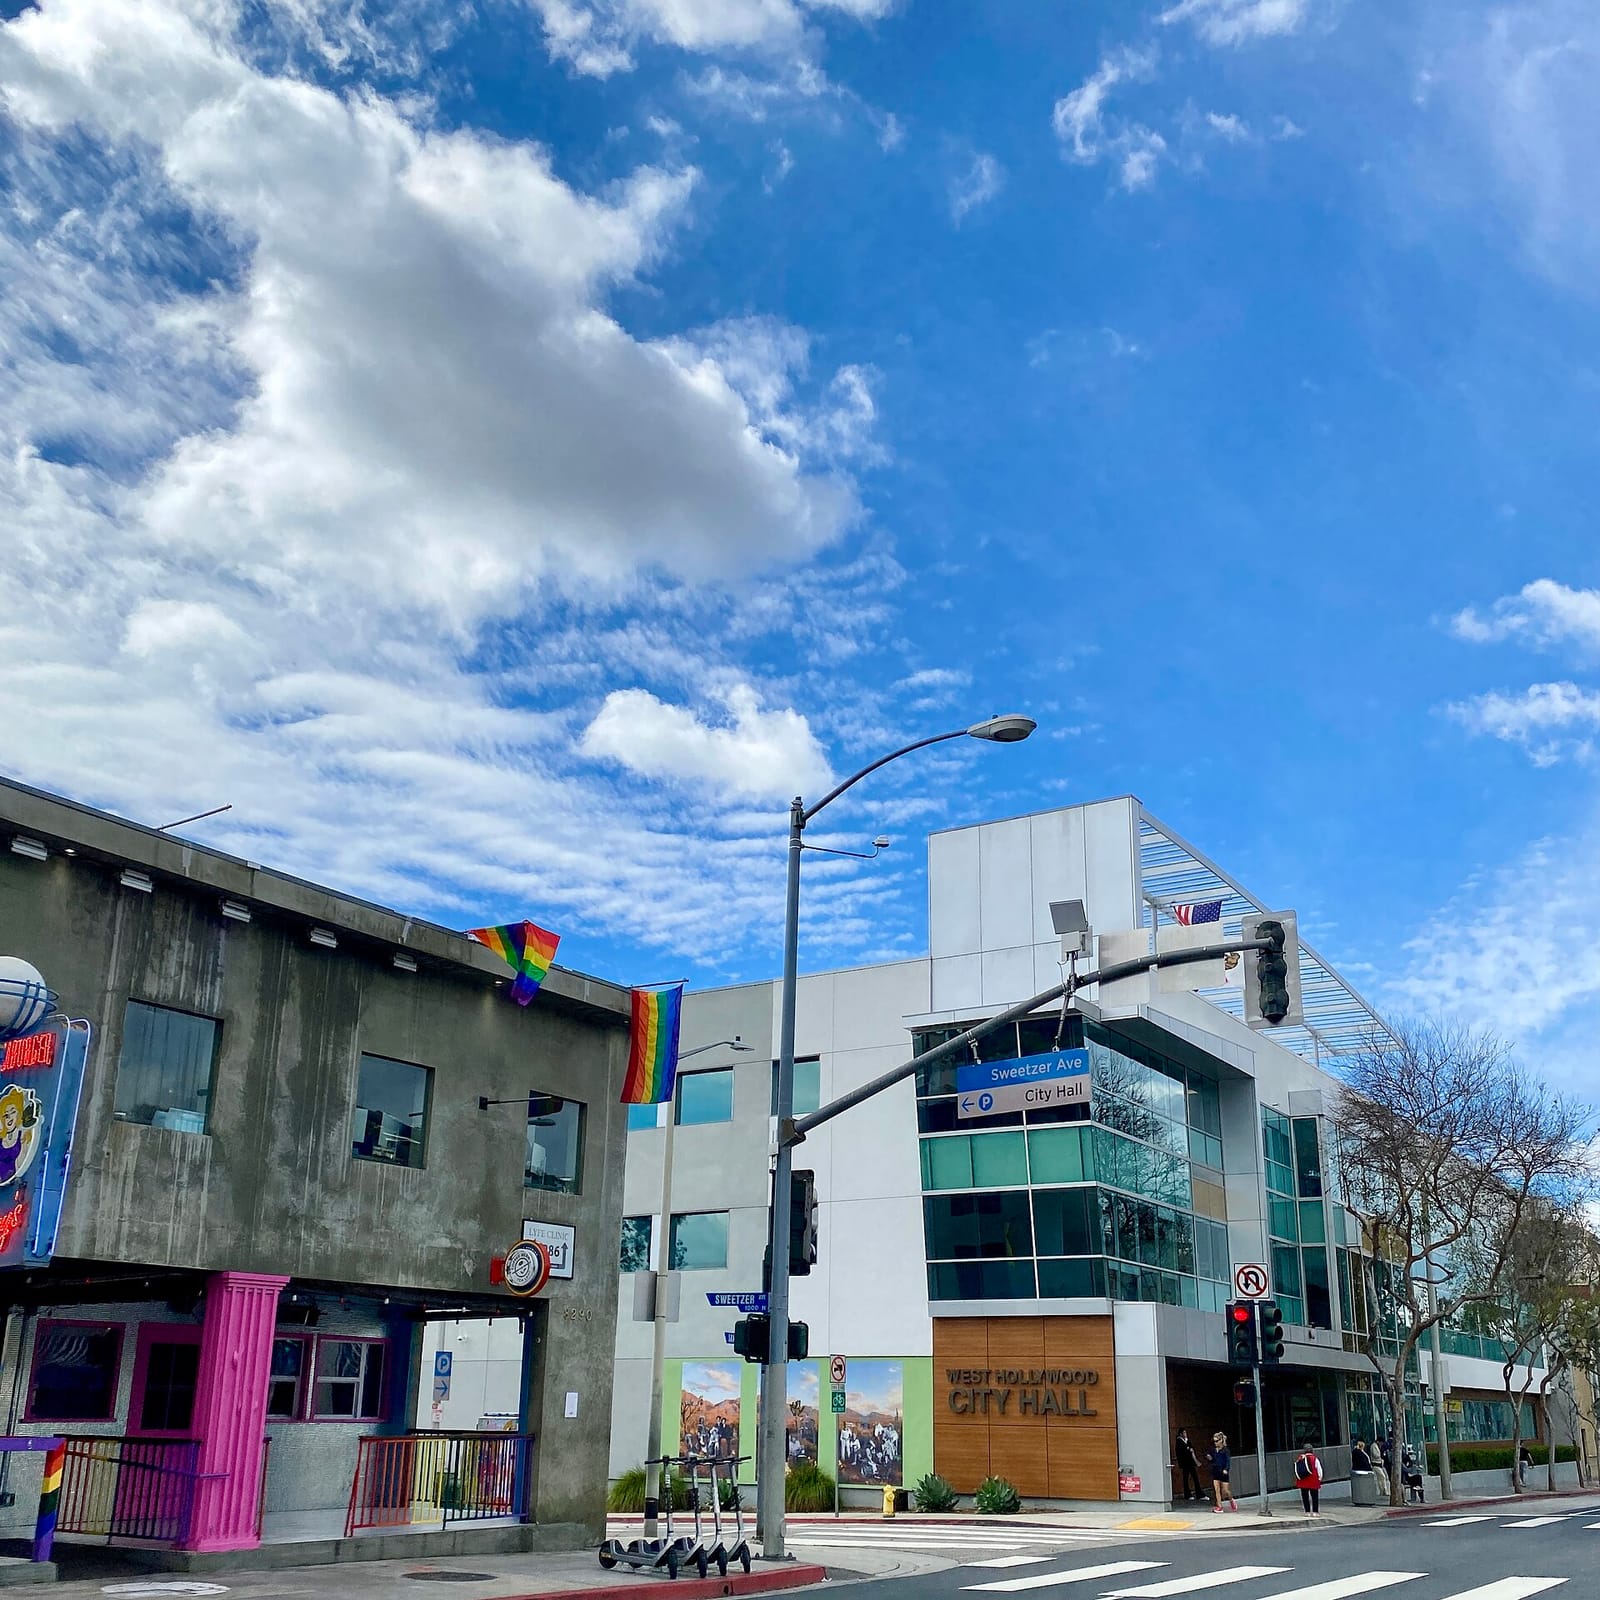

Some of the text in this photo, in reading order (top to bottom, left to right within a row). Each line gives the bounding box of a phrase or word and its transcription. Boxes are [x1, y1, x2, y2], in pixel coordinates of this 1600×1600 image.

[991, 1058, 1082, 1081] Sweetzer Ave
[1025, 1082, 1083, 1102] City Hall
[715, 1295, 755, 1304] SWEETZER
[946, 1369, 1098, 1385] WEST HOLLYWOOD
[949, 1388, 1098, 1416] CITY HALL
